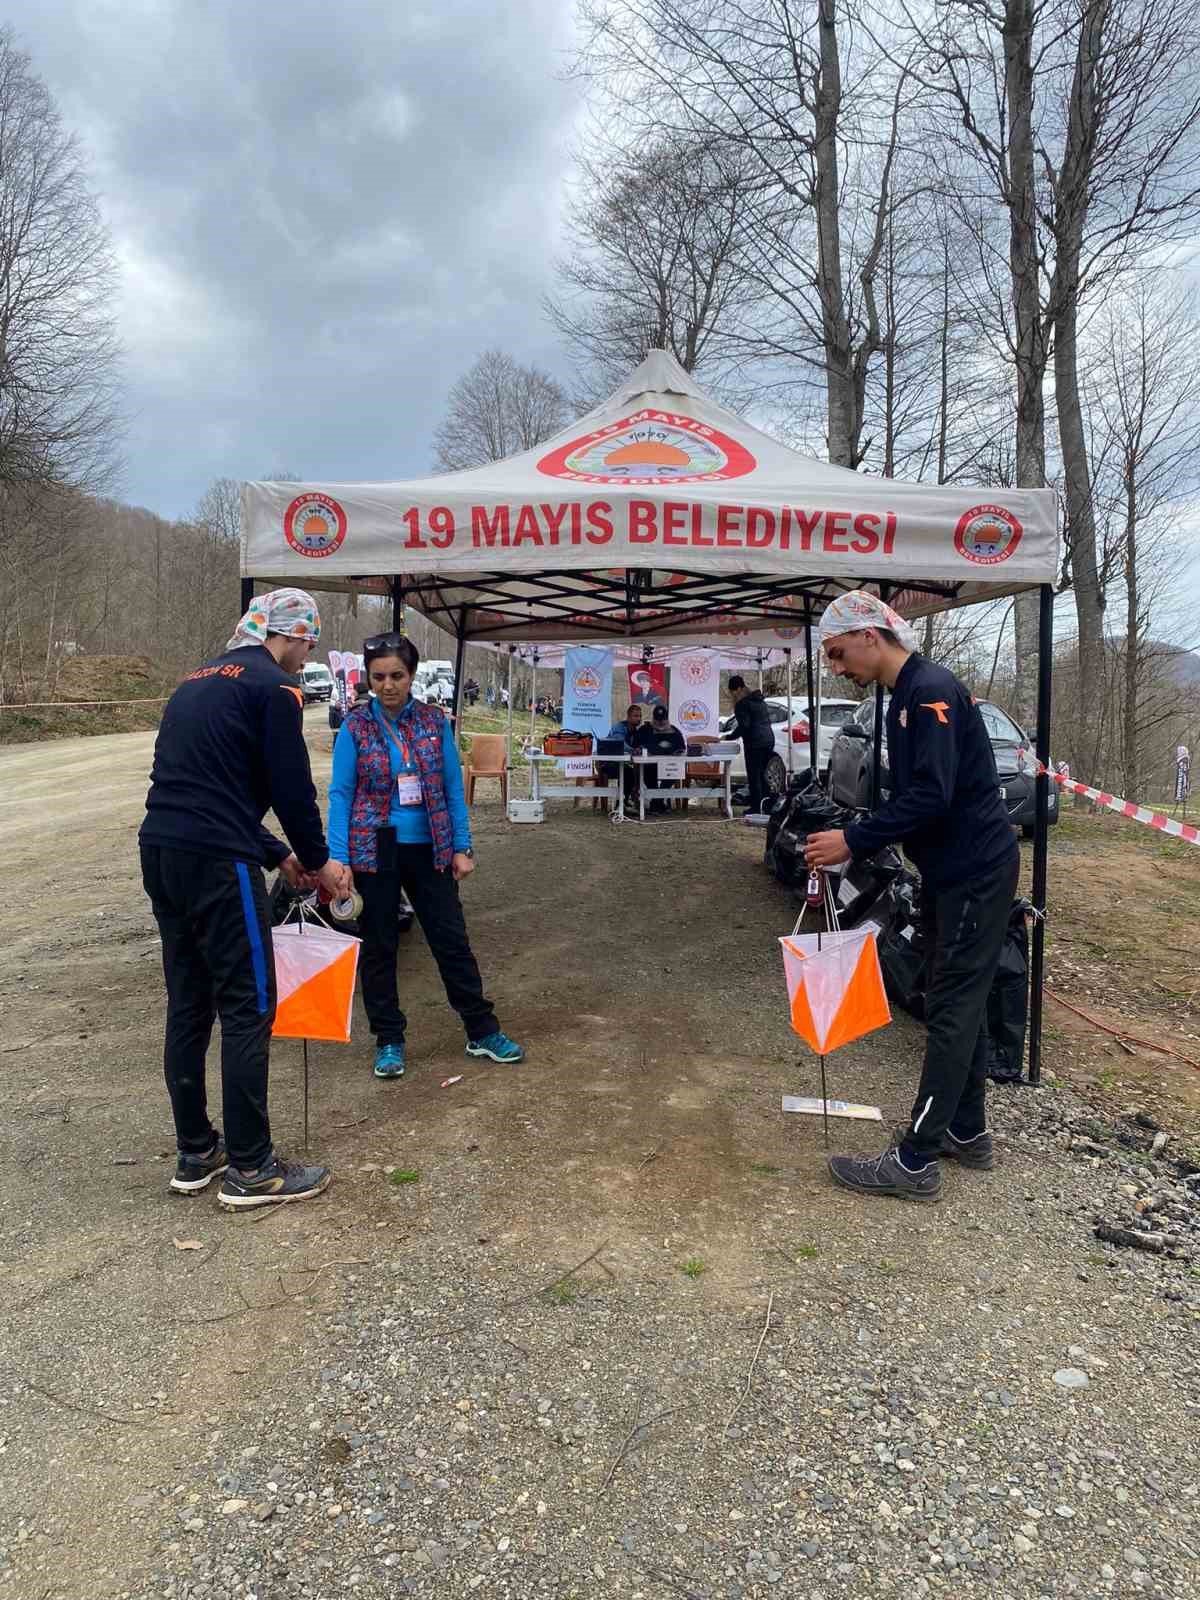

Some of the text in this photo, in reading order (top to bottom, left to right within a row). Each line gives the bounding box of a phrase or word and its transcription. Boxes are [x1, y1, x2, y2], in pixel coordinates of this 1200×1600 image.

[591, 411, 715, 439] 19 MAYIS
[980, 506, 1010, 519] MAYIS
[402, 500, 898, 555] 19 MAYIS BELEDİYESİ
[221, 664, 245, 678] SK
